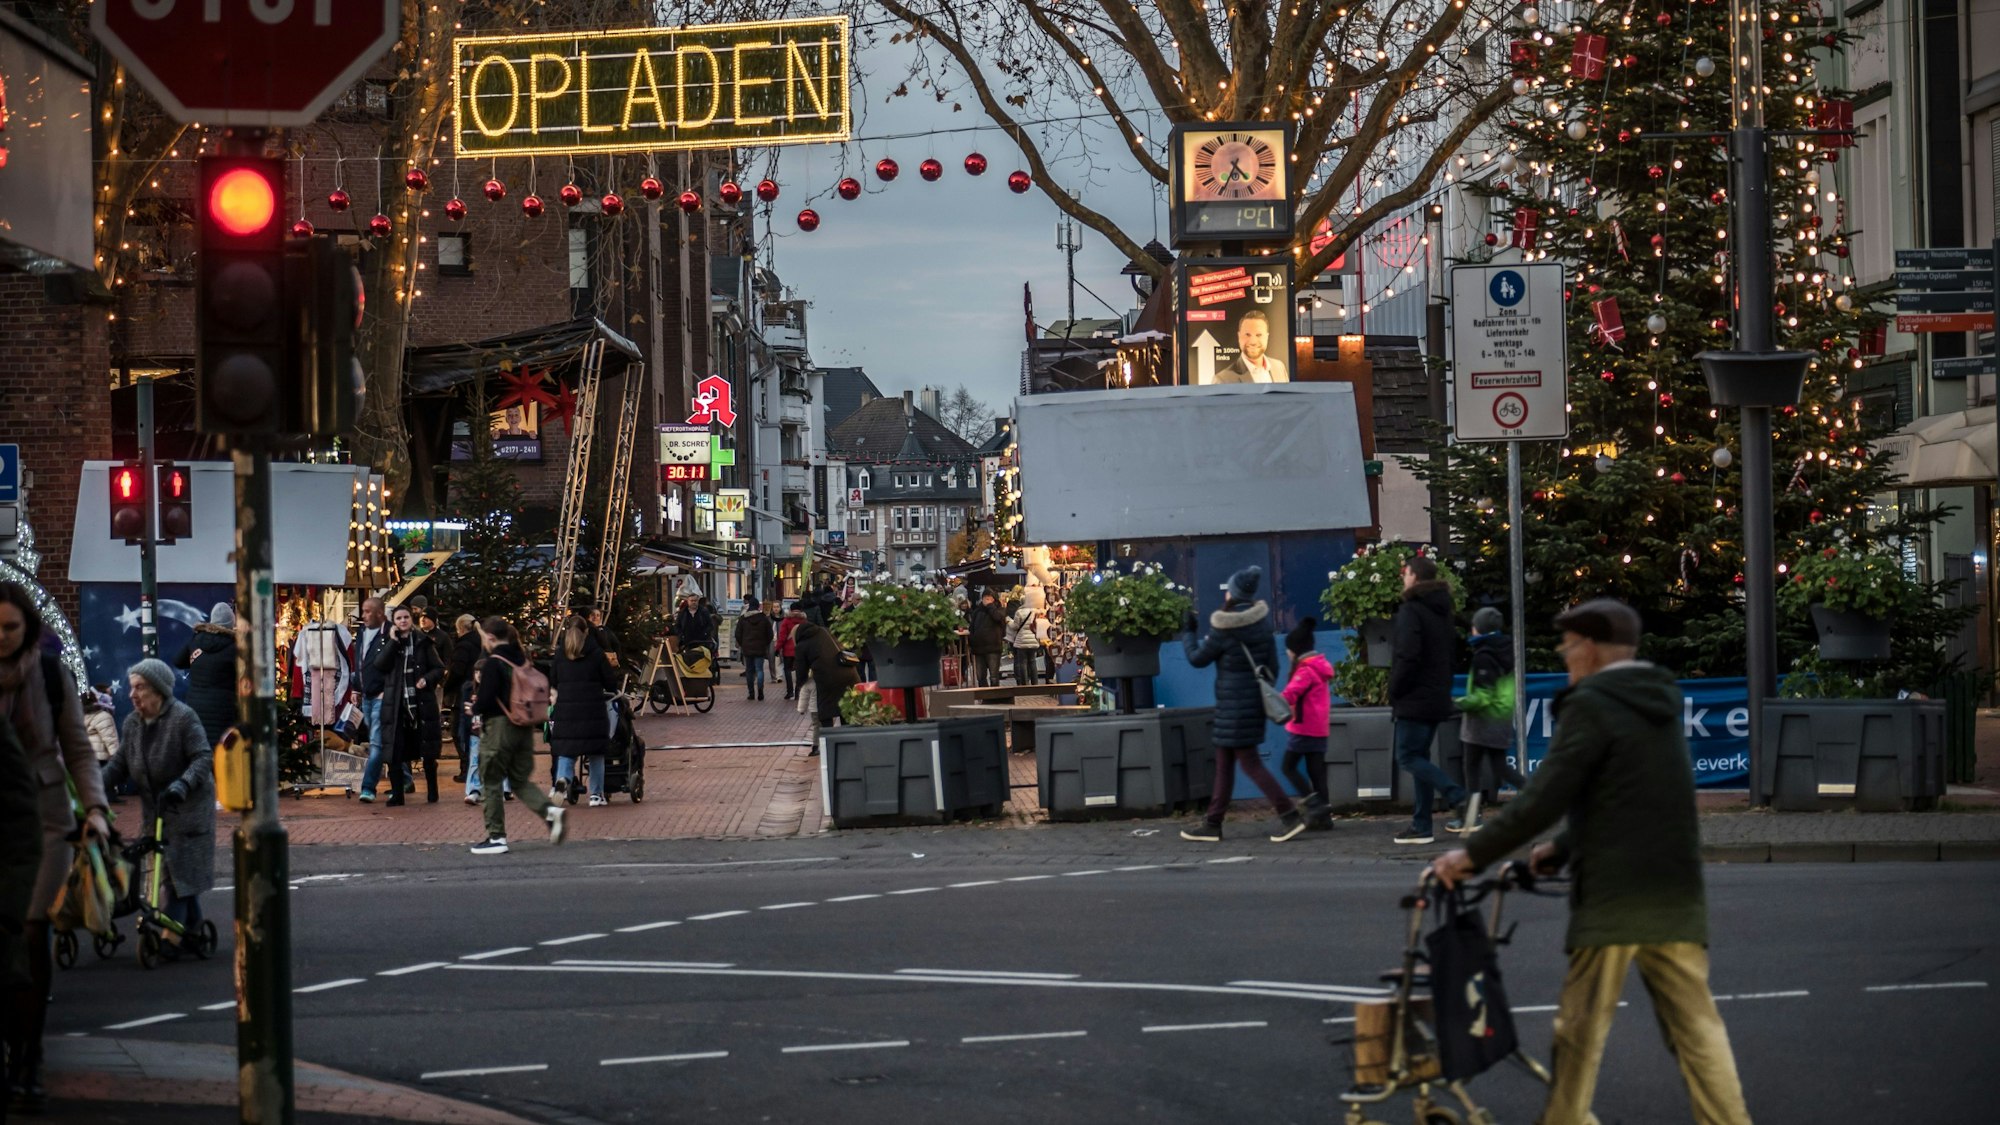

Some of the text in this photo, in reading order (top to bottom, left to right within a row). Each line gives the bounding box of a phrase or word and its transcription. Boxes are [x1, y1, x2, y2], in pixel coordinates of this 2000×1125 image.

[469, 37, 829, 137] OPLADEN
[1929, 272, 1957, 281] Opladen
[1228, 279, 1252, 288] Internet
[1201, 294, 1213, 303] und
[1499, 308, 1517, 316] Zone
[1473, 318, 1505, 328] Radfahrer
[1506, 318, 1518, 327] frei
[1899, 317, 1934, 325] Opladener
[1486, 328, 1530, 338] Lieferverkehr
[1493, 339, 1523, 350] werktags
[1503, 360, 1516, 369] frei
[1474, 374, 1538, 386] Feuerwehrzufahrt
[668, 465, 705, 479] 30.11
[1123, 544, 1131, 556] 7
